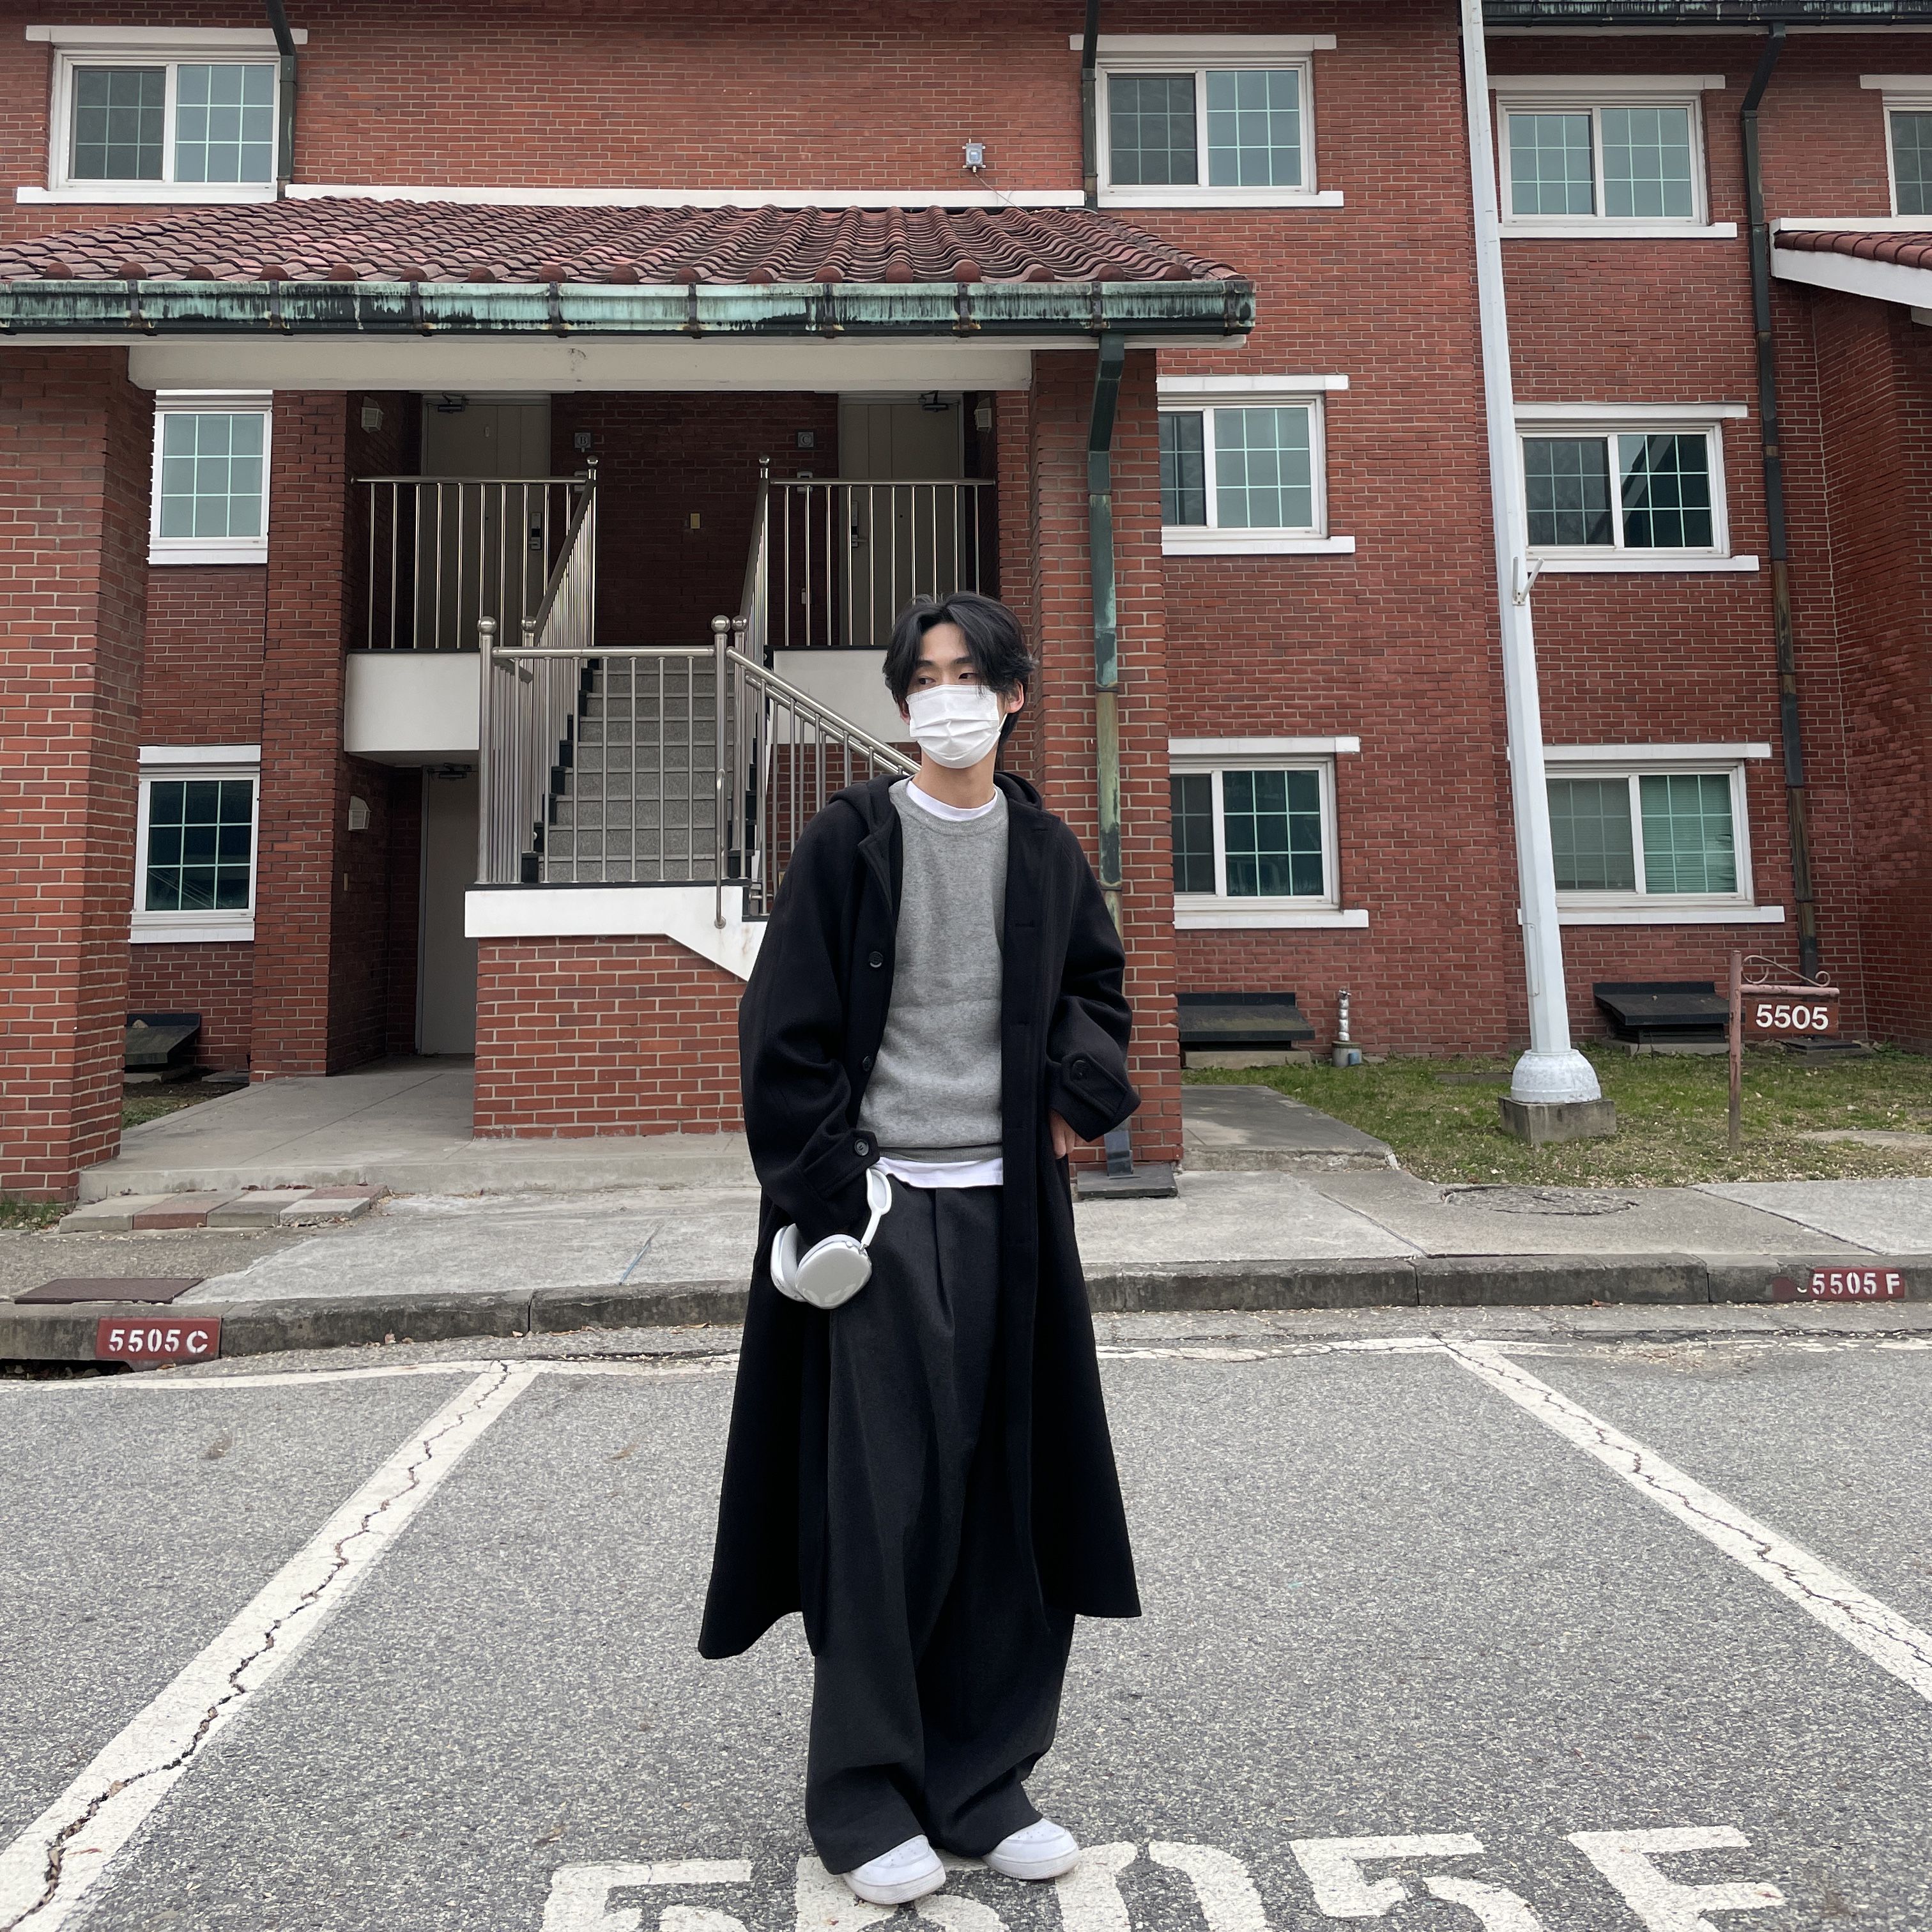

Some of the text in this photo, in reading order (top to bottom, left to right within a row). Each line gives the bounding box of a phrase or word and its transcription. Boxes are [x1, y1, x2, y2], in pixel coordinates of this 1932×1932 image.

[580, 436, 586, 445] B
[1756, 1004, 1828, 1031] 5505
[1812, 1272, 1900, 1295] 5505 F
